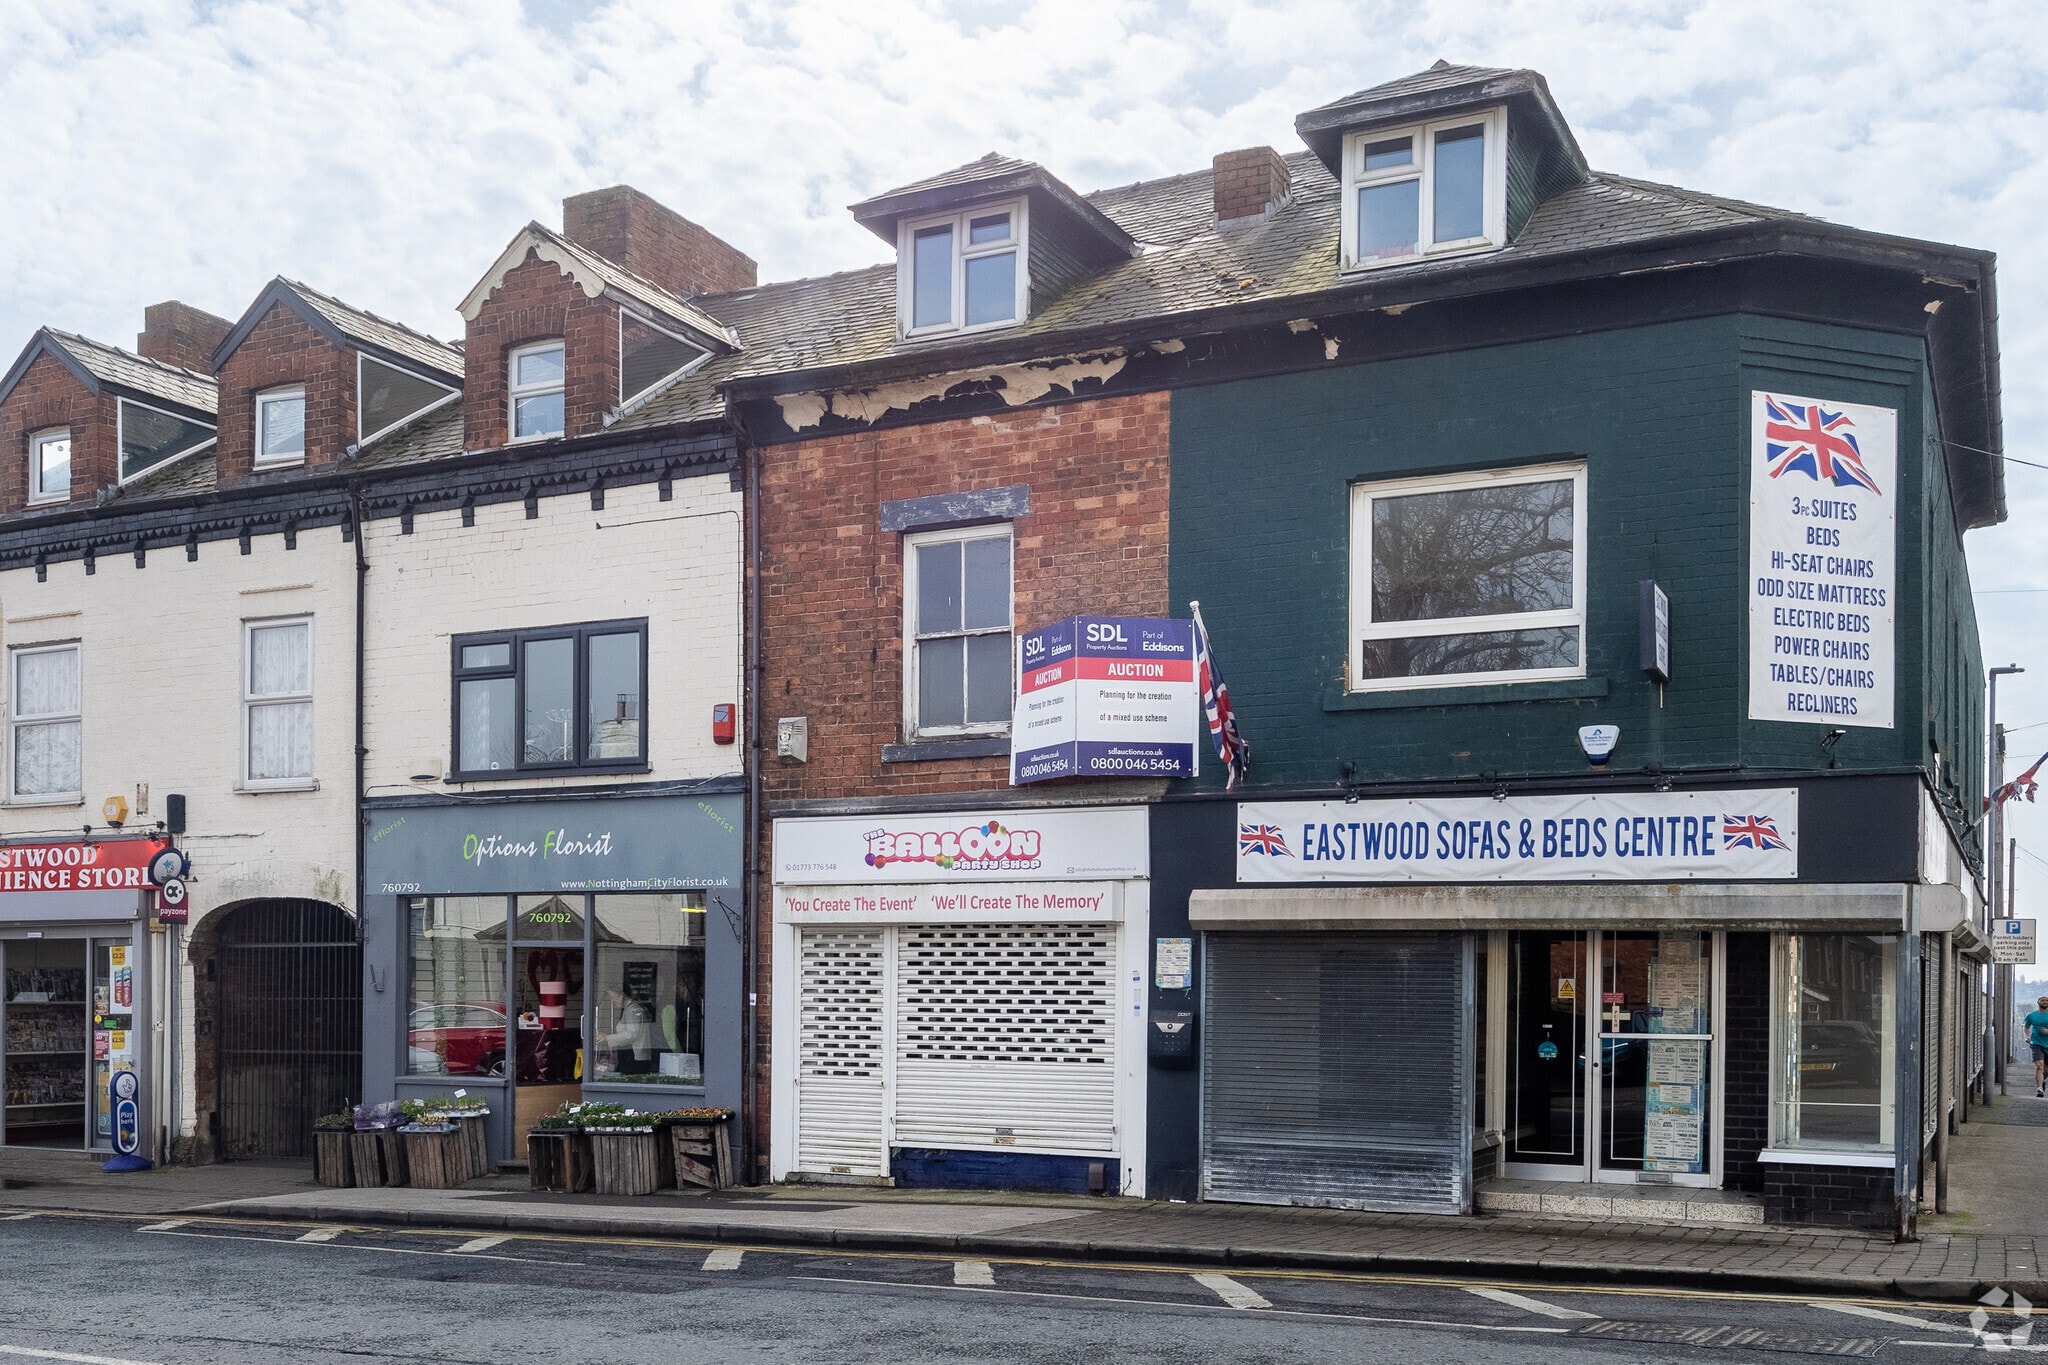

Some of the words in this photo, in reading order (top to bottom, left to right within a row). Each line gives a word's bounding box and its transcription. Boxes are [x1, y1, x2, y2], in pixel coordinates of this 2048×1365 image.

[1812, 499, 1857, 521] SUITES
[1807, 526, 1840, 547] BEDS
[1772, 551, 1824, 573] HI-SEAT
[1827, 556, 1874, 578] CHAIRS
[1758, 578, 1784, 597] ODD
[1788, 581, 1814, 600] SIZE
[1818, 584, 1886, 606] MATTRESS
[1774, 608, 1834, 630] ELECTRIC
[1838, 613, 1870, 633] BEDS
[1086, 624, 1128, 642] SDL
[1142, 630, 1155, 638] Part
[1026, 635, 1046, 657] SDL
[1052, 643, 1072, 656] Eddisons
[1142, 642, 1184, 652] Eddisons
[1775, 636, 1819, 657] POWER
[1823, 640, 1870, 661] CHAIRS
[1035, 666, 1062, 686] AUCTION
[1108, 663, 1163, 677] AUCTION
[1770, 664, 1874, 688] TABLES/CHAIRS
[1100, 690, 1125, 700] Planning
[1127, 691, 1135, 699] for
[1137, 691, 1146, 699] the
[1148, 692, 1172, 700] creation
[1788, 693, 1858, 715] RECLINERS
[1113, 713, 1131, 721] mixed
[1145, 714, 1168, 722] scheme
[1108, 747, 1163, 756] sdlauctions.co.uk
[1021, 765, 1038, 777] 0800
[1039, 762, 1051, 774] 046
[1052, 759, 1068, 771] 5454
[1091, 757, 1123, 769] 0800
[1125, 758, 1148, 770] 046
[1150, 759, 1180, 770] 5454
[697, 801, 735, 834] eflorist
[372, 816, 407, 842] eflorist
[863, 828, 886, 841] THE
[1303, 822, 1429, 861] EASTWOOD
[1436, 820, 1511, 860] SOFAS
[1518, 818, 1535, 858] &
[1543, 817, 1607, 858] BEDS
[1615, 815, 1716, 857] CENTRE
[463, 834, 538, 866] Options
[544, 828, 613, 860] Florist
[869, 826, 1041, 862] BALLOON
[0, 847, 98, 868] STWOOD
[952, 859, 999, 870] PARTY
[999, 858, 1041, 870] SHOP
[0, 870, 70, 889] IENCE
[382, 883, 420, 893] 760792
[812, 898, 850, 911] Create
[854, 897, 876, 911] The
[970, 895, 1011, 909] Create
[1016, 895, 1039, 909] The
[160, 908, 187, 916] payzone
[529, 913, 571, 922] 760792
[2010, 923, 2019, 933] P
